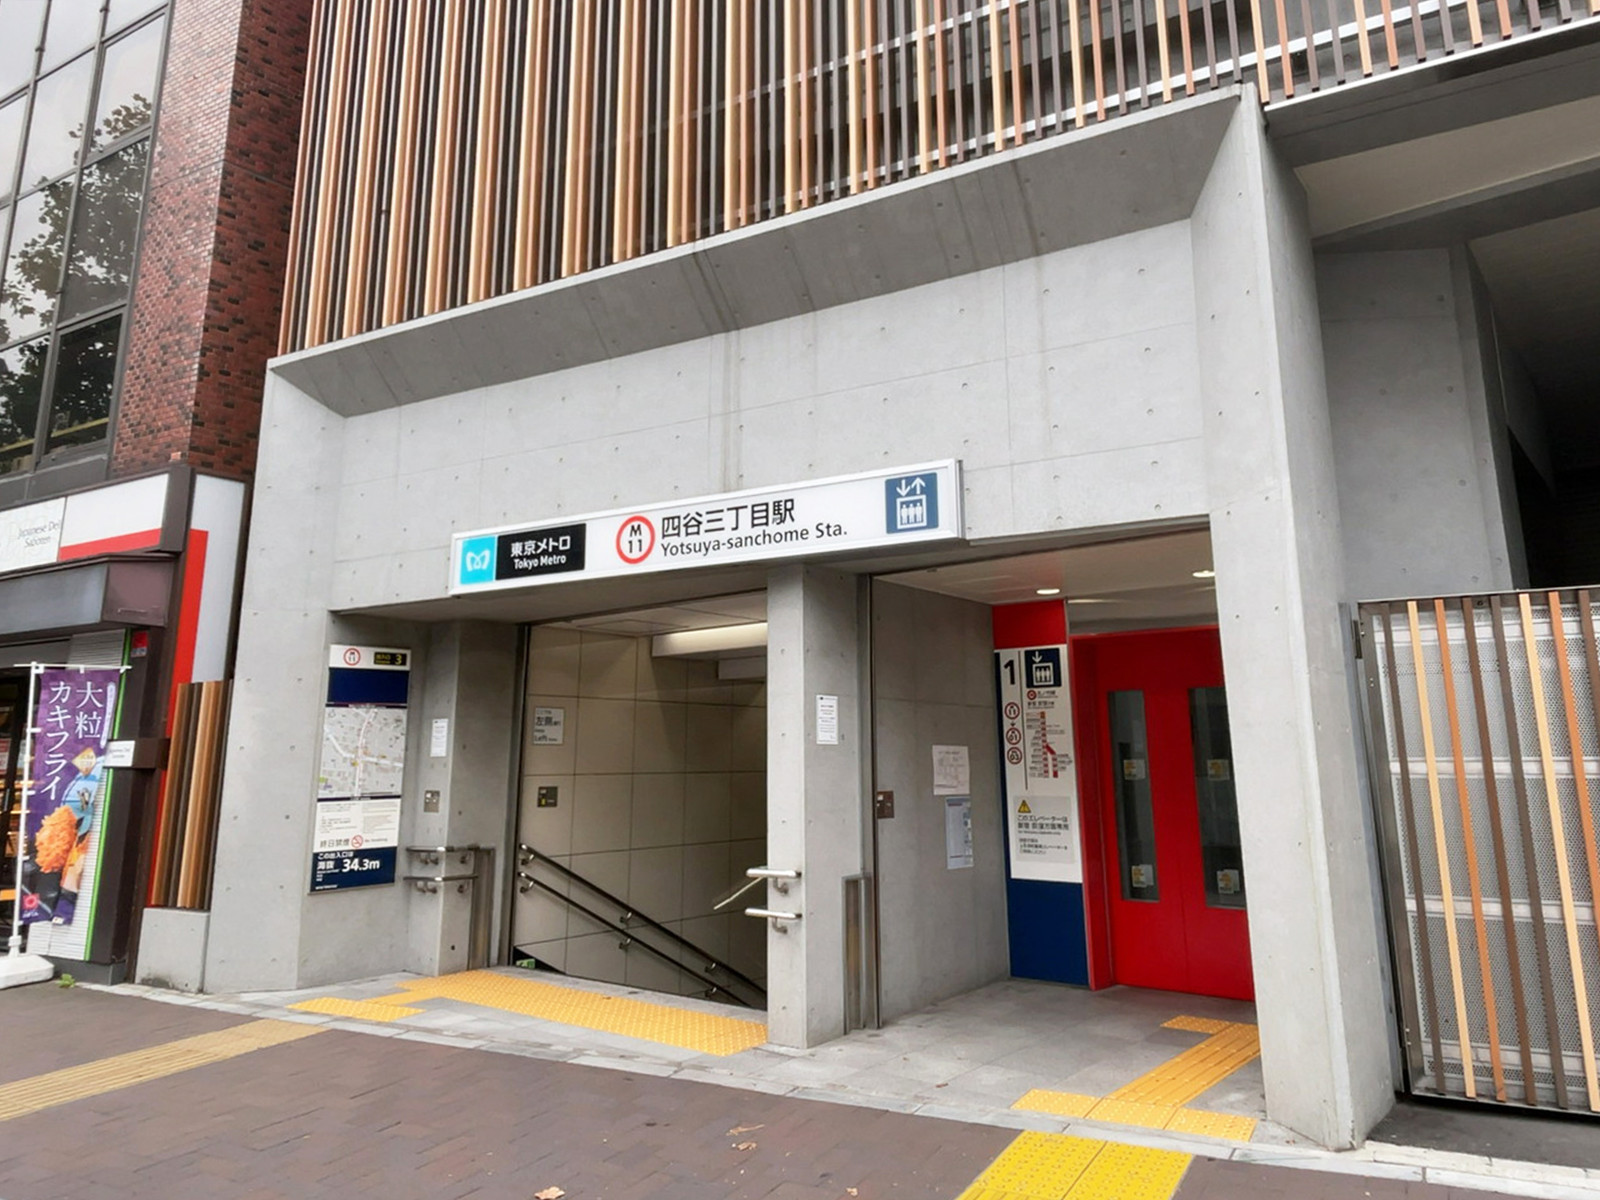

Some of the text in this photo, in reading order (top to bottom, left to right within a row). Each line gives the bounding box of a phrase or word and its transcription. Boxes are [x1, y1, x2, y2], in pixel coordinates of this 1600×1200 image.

[661, 498, 795, 540] 四谷三丁目駅
[630, 524, 643, 537] M
[661, 522, 848, 557] Yotsuya-sanchome Sta.
[510, 535, 571, 557] 東京メトロ
[628, 540, 643, 554] 11
[514, 555, 567, 570] Tokyo Metro
[395, 653, 403, 666] 3
[1003, 659, 1016, 685] 1
[75, 681, 104, 739] 大粒
[40, 681, 72, 800] カキフライ
[317, 852, 354, 860] この出入口は
[341, 858, 380, 873] 34.3m
